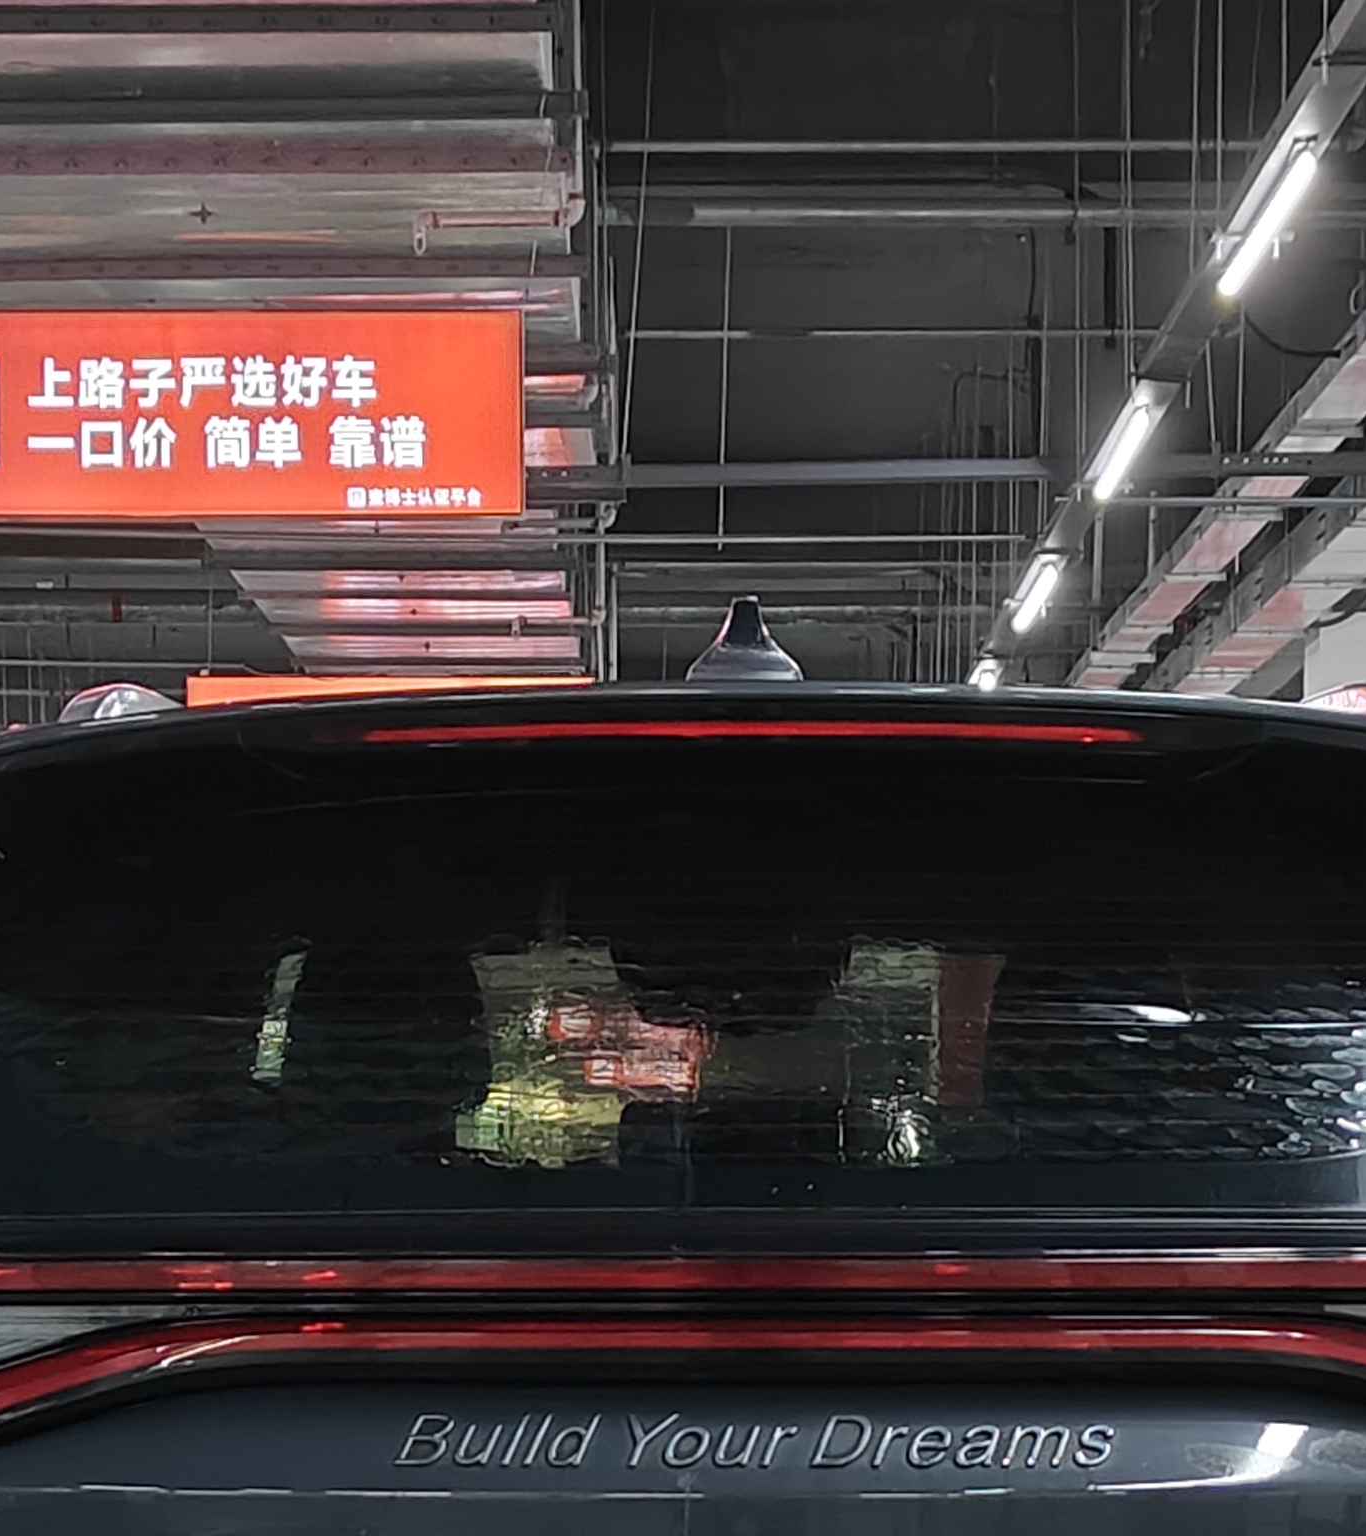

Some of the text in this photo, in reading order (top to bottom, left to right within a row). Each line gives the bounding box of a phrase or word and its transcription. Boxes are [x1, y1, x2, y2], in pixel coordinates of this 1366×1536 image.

[26, 353, 378, 409] 上路子严选好车
[26, 415, 428, 469] 一口价 简单 靠谱
[392, 1412, 1118, 1468] Build Your Dreams
